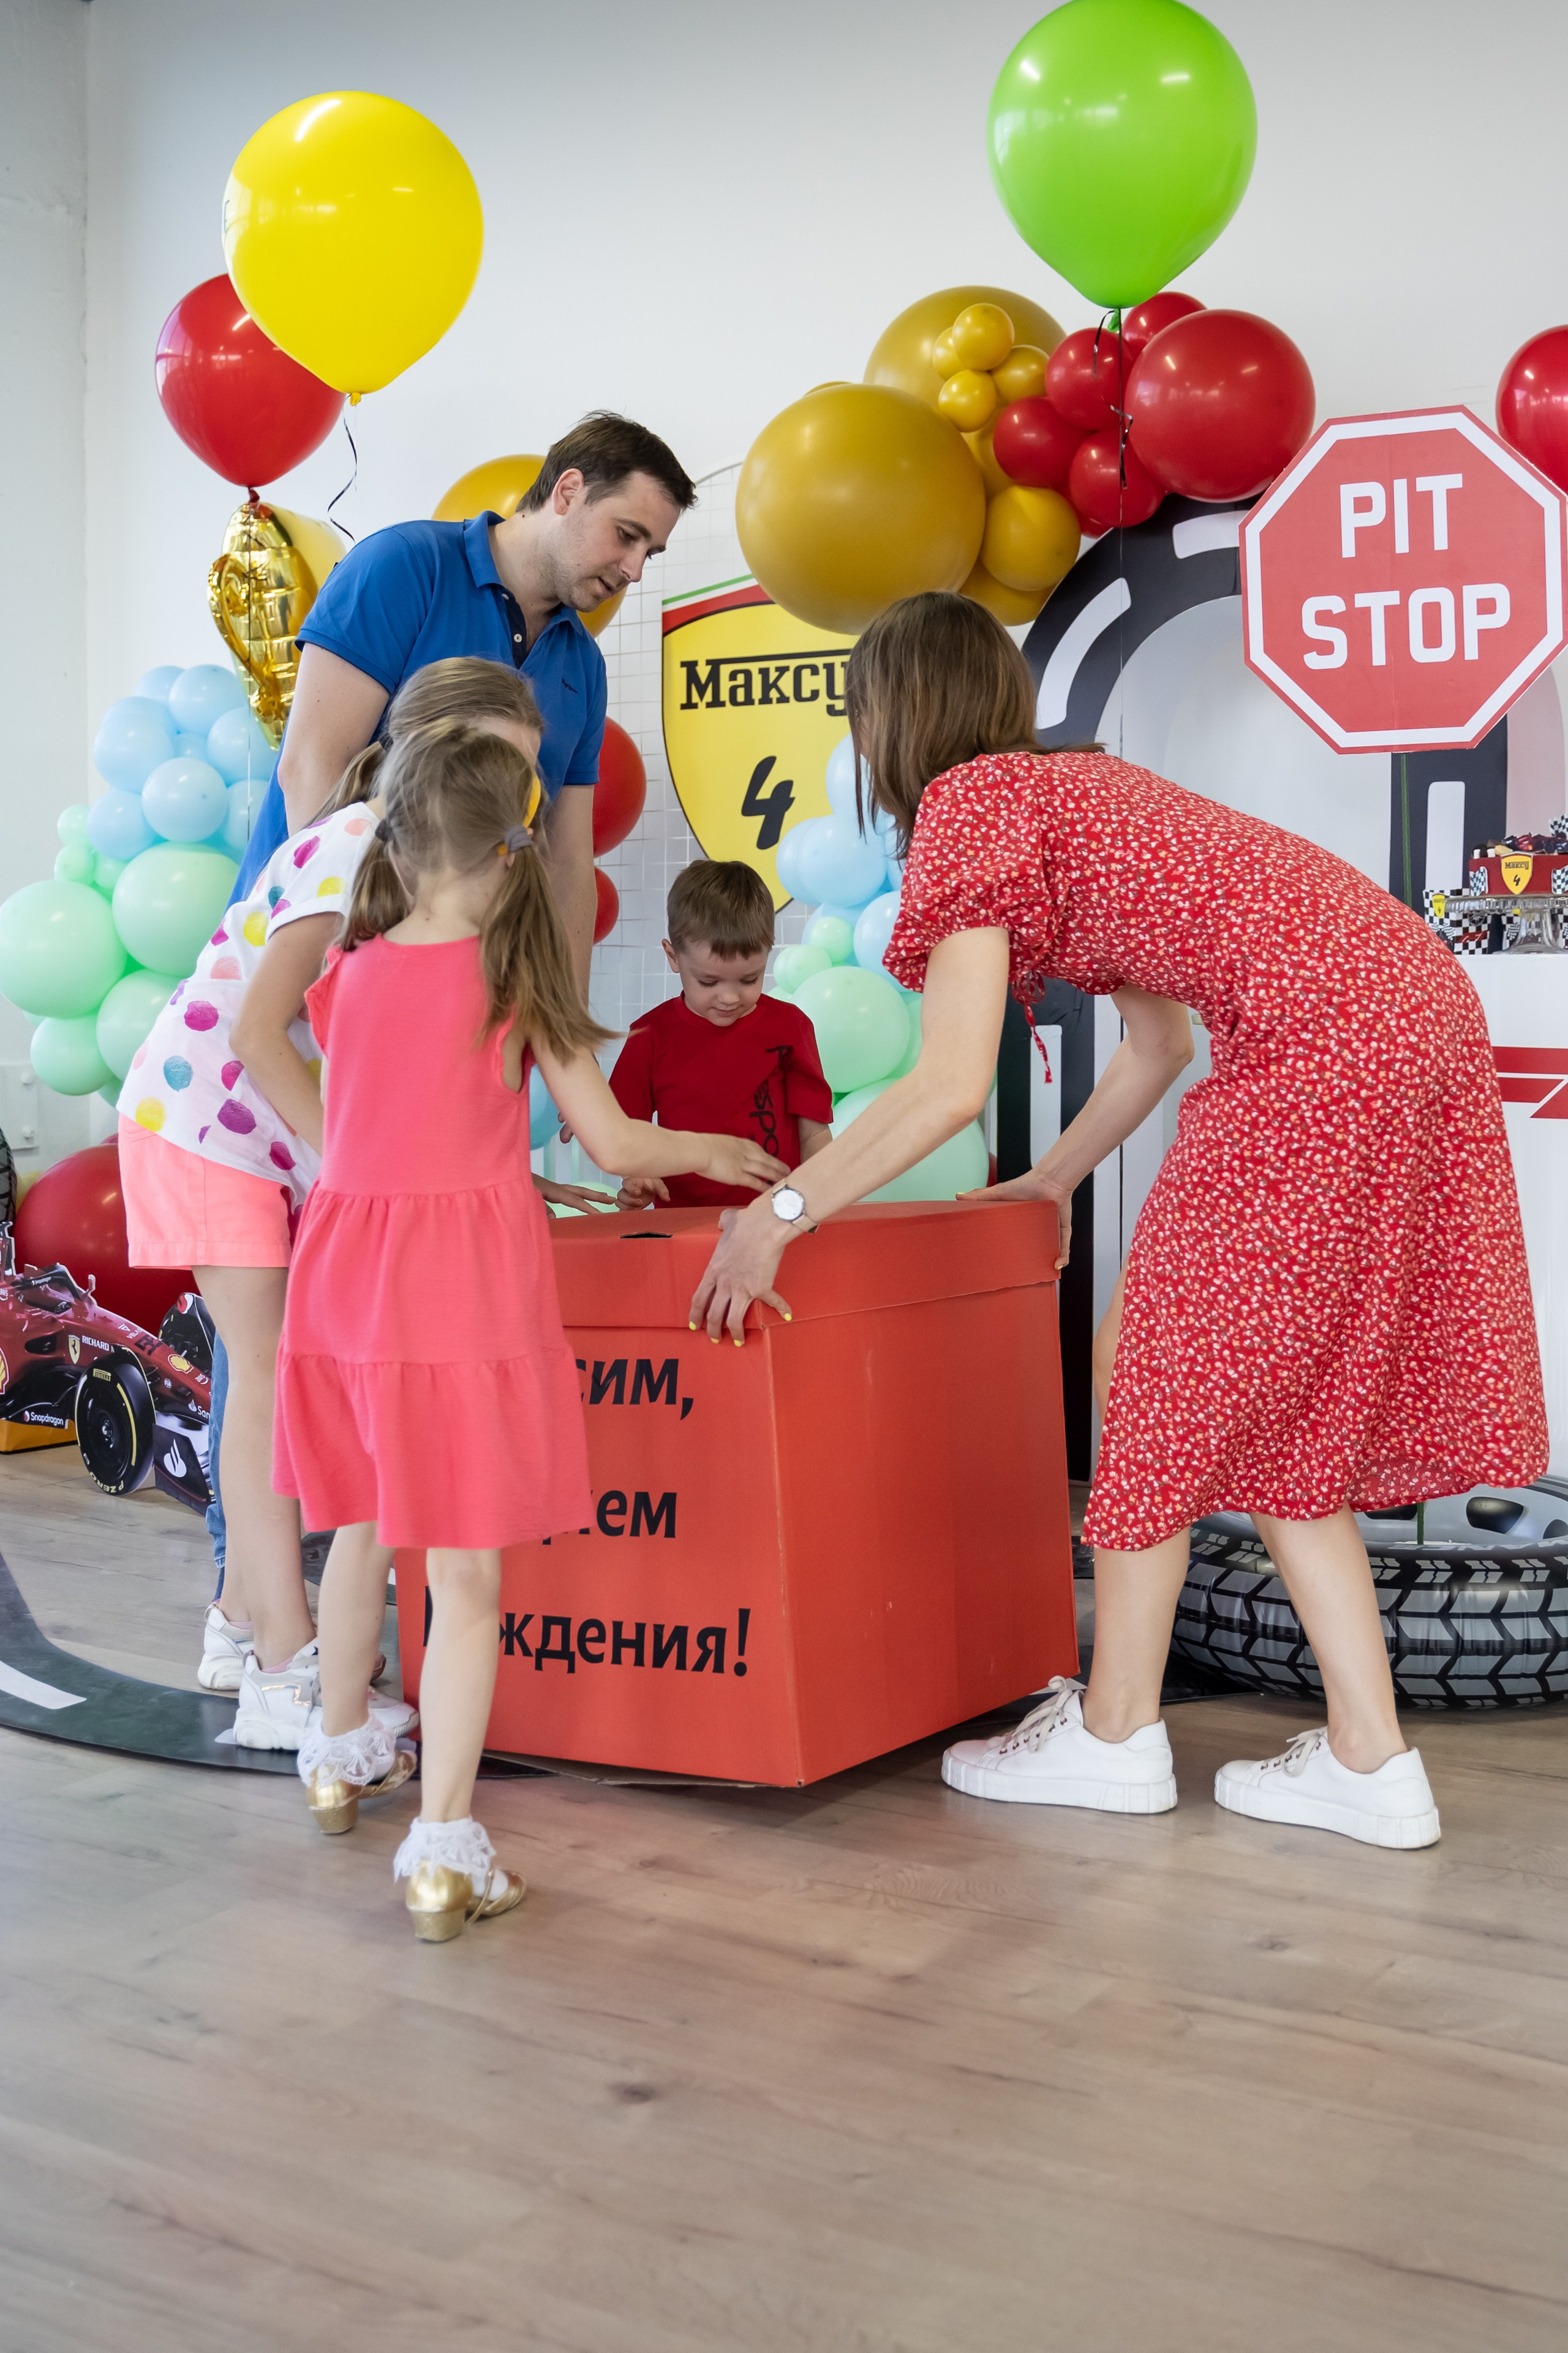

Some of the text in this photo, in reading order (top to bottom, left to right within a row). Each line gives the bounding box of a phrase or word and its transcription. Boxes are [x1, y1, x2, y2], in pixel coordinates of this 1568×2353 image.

[1340, 474, 1463, 558] PIT
[1302, 583, 1510, 670] STOP
[741, 756, 795, 850] 4
[1513, 874, 1521, 886] 4
[81, 1335, 110, 1351] RICHARD
[93, 1368, 111, 1381] PIRELLI
[30, 1411, 64, 1426] Snapdragon
[89, 1471, 117, 1493] ZERO
[423, 1586, 751, 1677] ждения!
